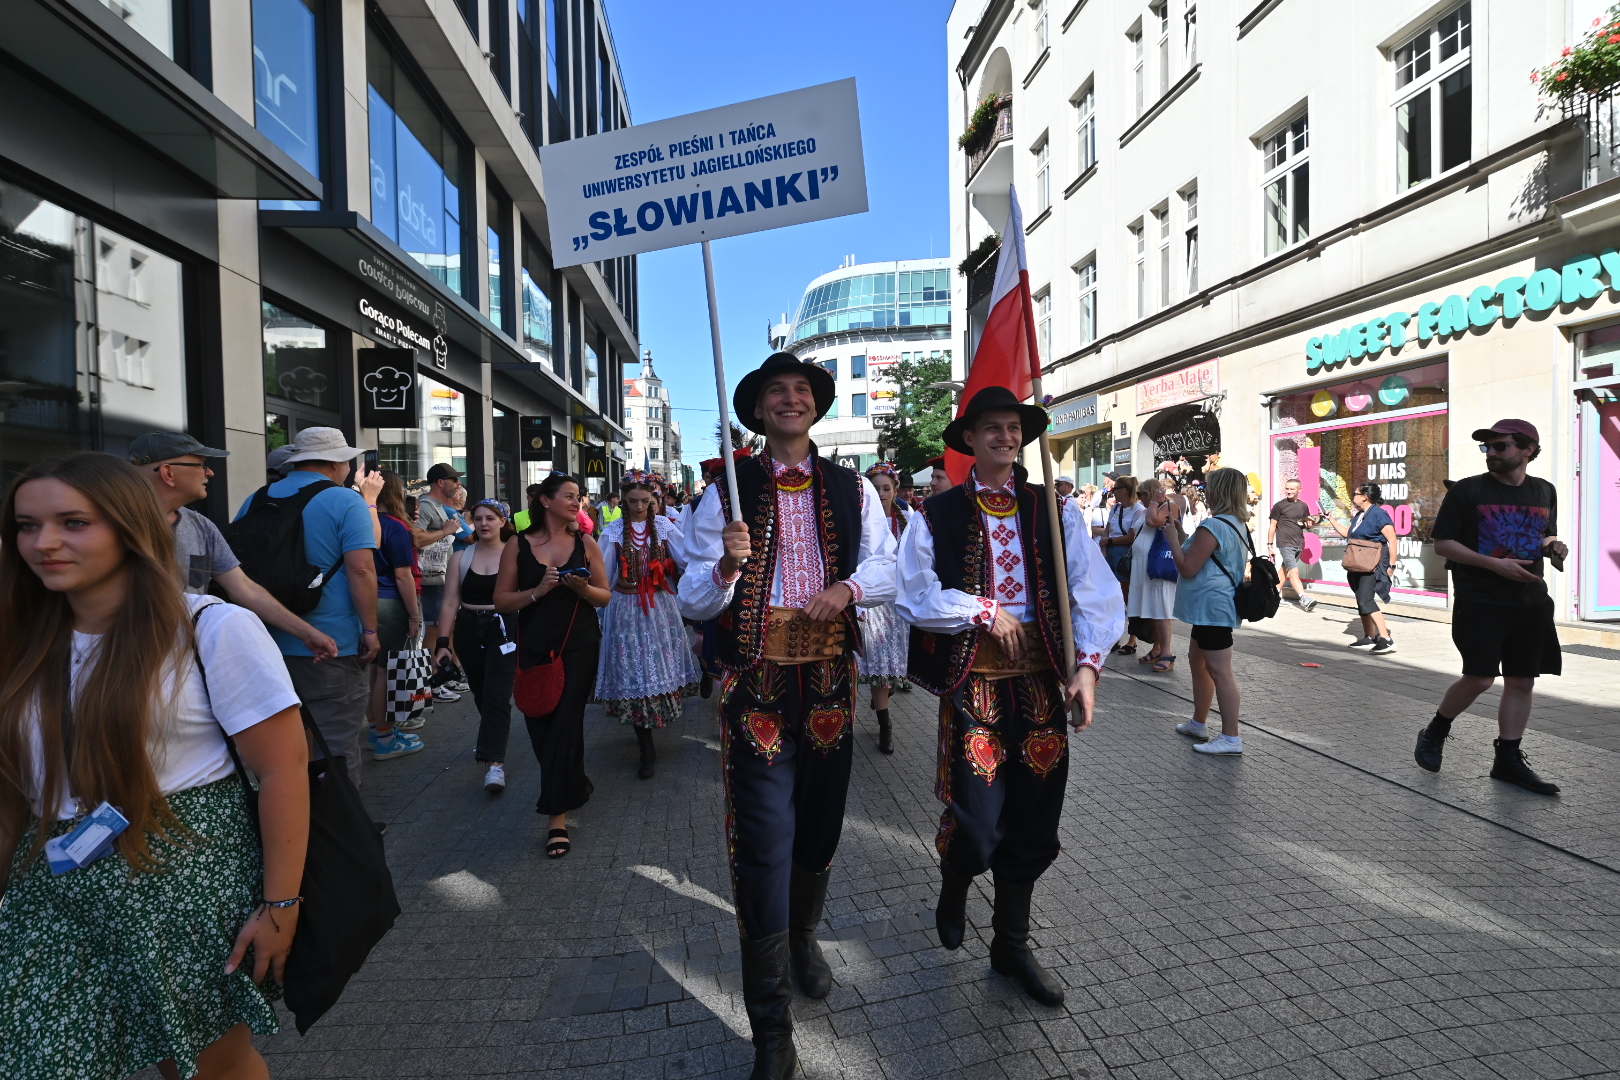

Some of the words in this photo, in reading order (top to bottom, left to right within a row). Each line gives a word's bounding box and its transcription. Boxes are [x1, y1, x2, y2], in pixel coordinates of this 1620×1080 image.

[615, 143, 665, 171] ZESPÓŁ
[669, 134, 714, 159] PIEŚNI
[719, 133, 725, 149] I
[729, 122, 776, 146] TAŃCA
[582, 164, 686, 199] UNIWERSYTETU
[690, 138, 817, 178] JAGIELLOŃSKIEGO
[360, 298, 395, 330] Gorąco
[396, 318, 431, 350] Polecam
[1306, 311, 1411, 369] SWEET
[1143, 379, 1175, 398] Yerba
[1179, 368, 1210, 386] Mate
[1056, 413, 1068, 425] BNP
[1068, 405, 1096, 423] PARIBAS
[1367, 440, 1407, 460] TYLKO
[1367, 464, 1377, 480] U
[1379, 462, 1407, 480] NAS
[1378, 483, 1409, 500] NAD
